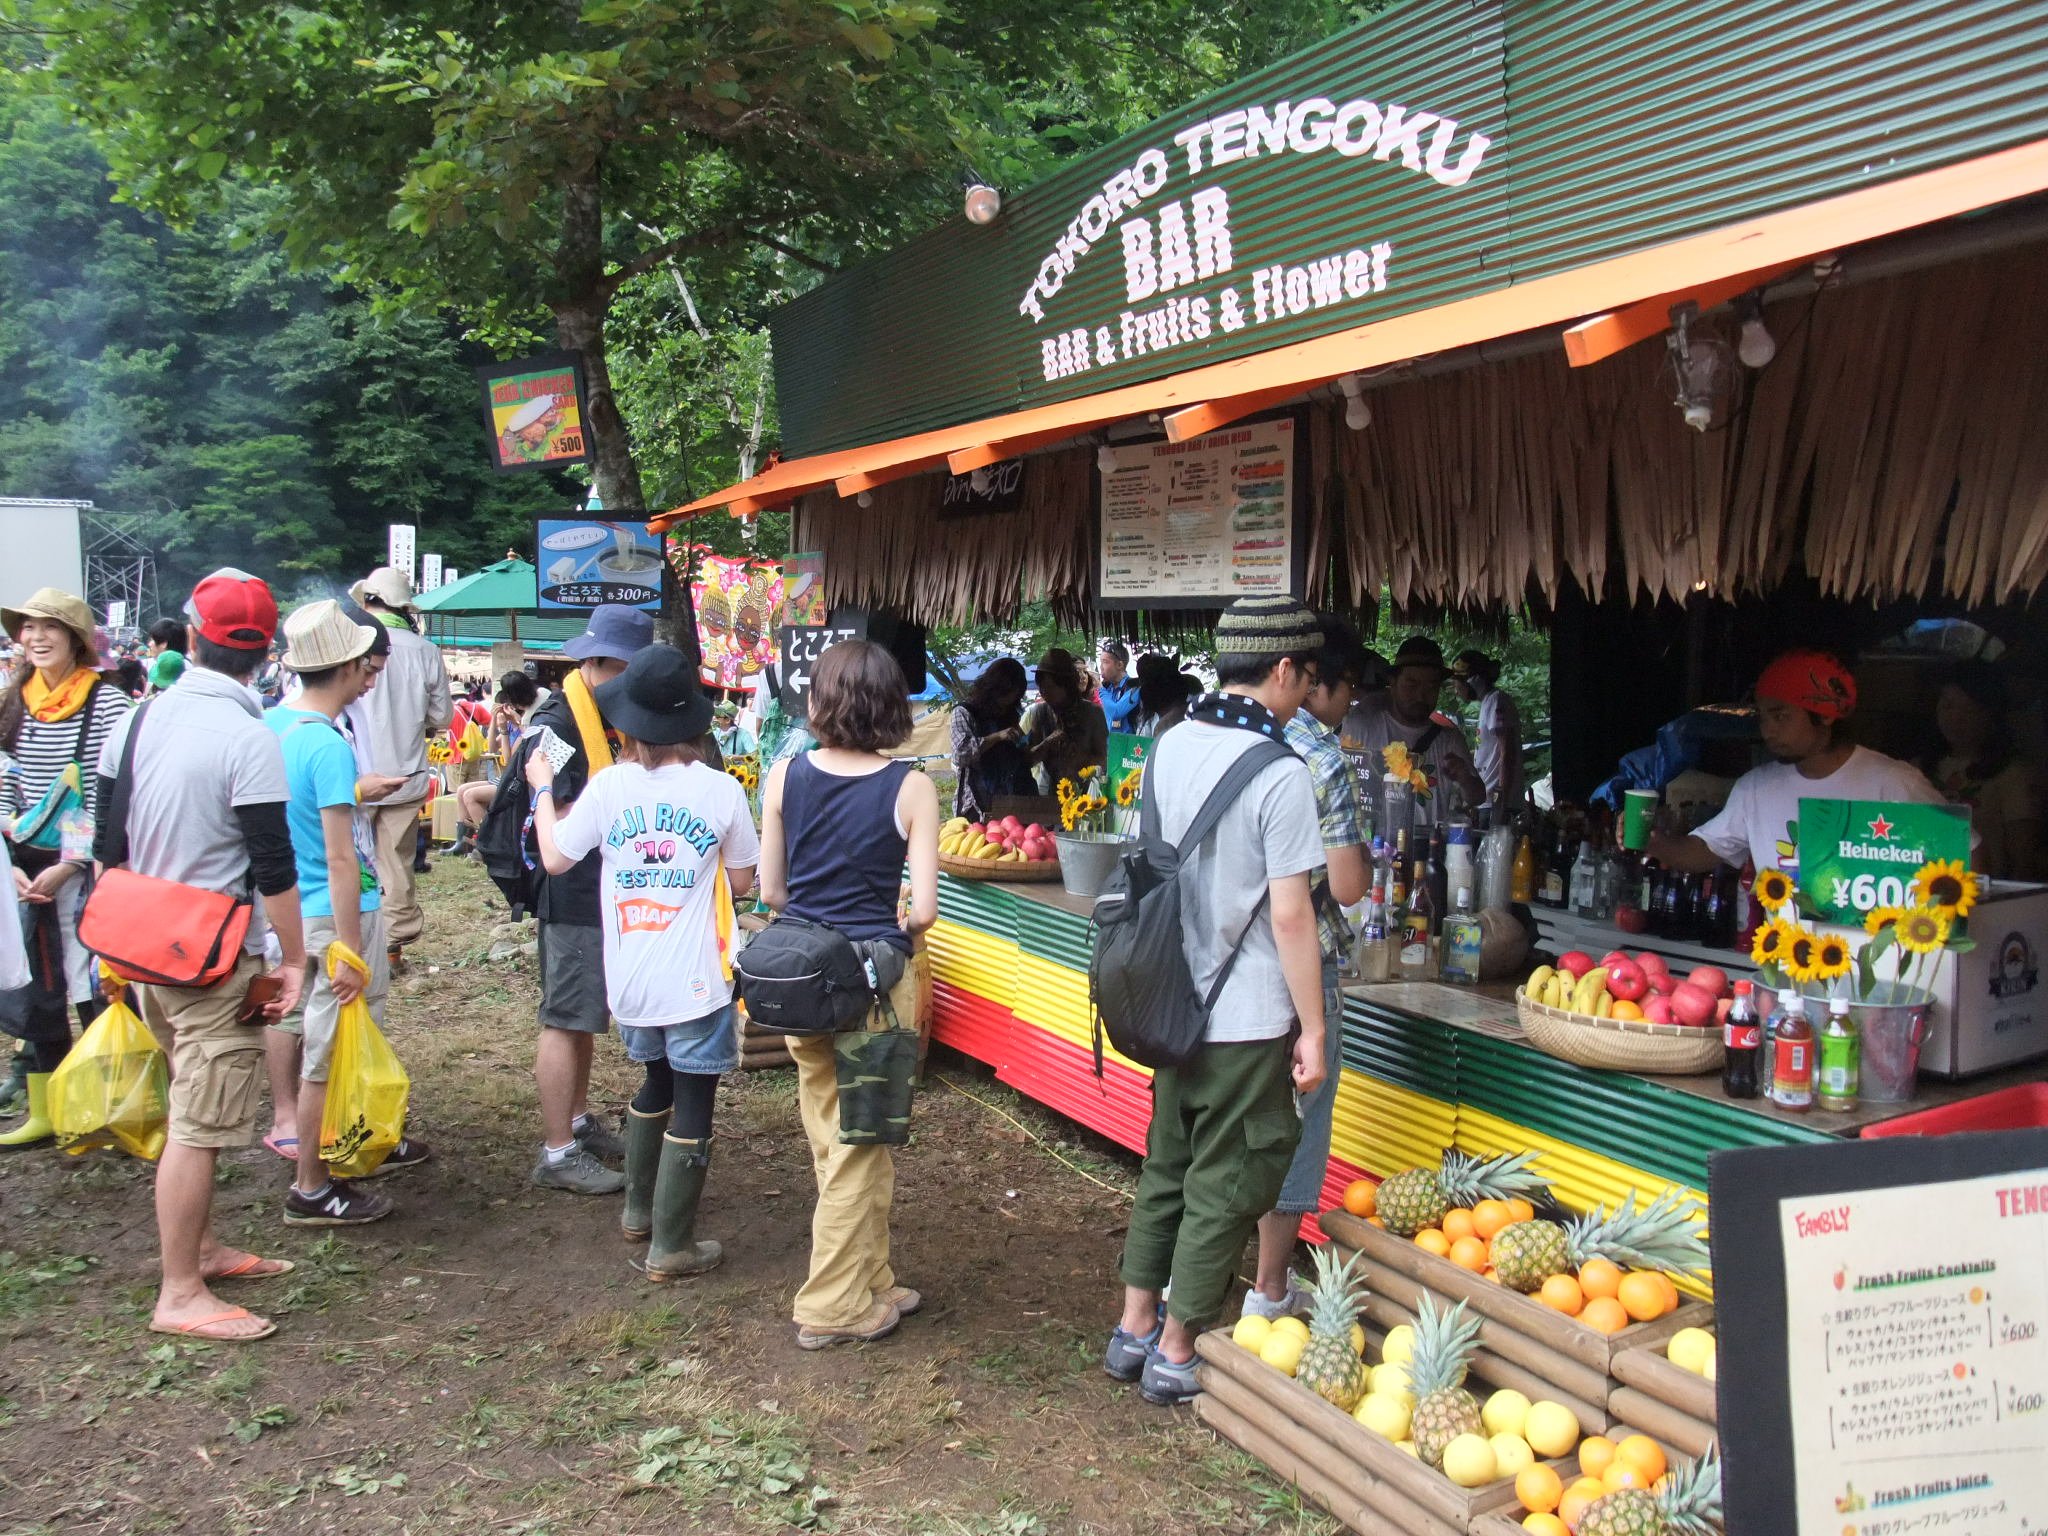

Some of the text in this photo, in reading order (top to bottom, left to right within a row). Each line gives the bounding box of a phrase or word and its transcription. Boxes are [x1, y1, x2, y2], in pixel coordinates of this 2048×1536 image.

[1020, 98, 1491, 323] TOKORO TENGOKU
[1120, 186, 1232, 303] BAR
[1042, 241, 1392, 381] BAR & Fruits & Flower
[522, 373, 574, 398] CHICKEN
[552, 436, 581, 454] ¥500
[559, 585, 602, 596] ところ天
[1350, 755, 1363, 765] AFT
[655, 803, 719, 858] ROCK
[634, 840, 676, 864] '10
[1839, 841, 1923, 863] Heineken
[324, 1197, 350, 1216] N
[1795, 1206, 1850, 1239] FAMBLY
[1857, 1259, 1996, 1290] Fresh Fruits Cocktails
[1875, 1473, 1989, 1505] Fresh Fruits Juice
